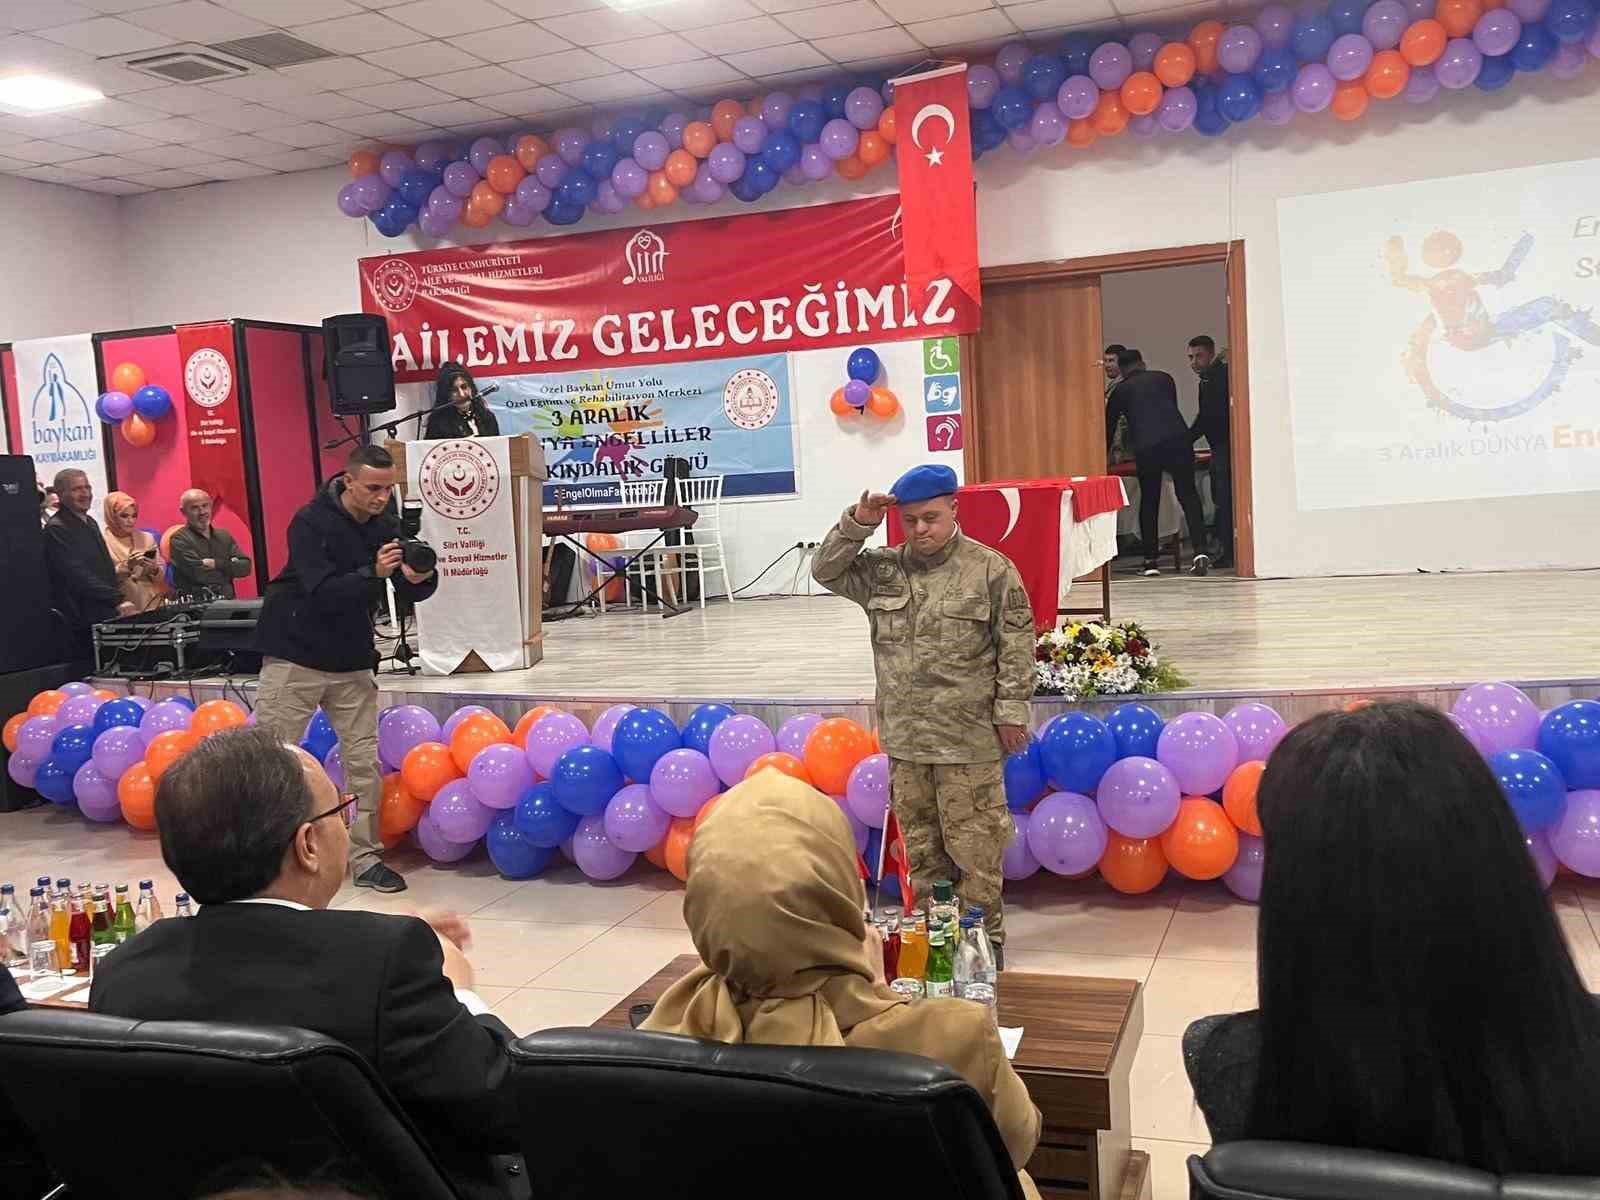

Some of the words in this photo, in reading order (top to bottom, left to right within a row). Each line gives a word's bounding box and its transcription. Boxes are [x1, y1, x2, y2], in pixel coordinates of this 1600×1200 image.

[391, 312, 579, 374] AİLEMİZ
[592, 274, 956, 357] GELECEĞİMİZ
[566, 383, 604, 395] Baykan
[606, 380, 635, 390] Umut
[638, 377, 663, 388] Yolu
[579, 389, 655, 404] Rehabilitasyon
[657, 386, 702, 398] Merkezi
[551, 410, 563, 427] 3
[570, 405, 650, 425] ARALIK
[32, 419, 93, 452] baykan
[580, 426, 712, 449] ENGELLİLER
[1377, 447, 1393, 463] 3
[546, 458, 644, 478] KINDALIK
[456, 526, 472, 535] T.C.
[443, 540, 458, 549] Siirt
[460, 539, 485, 550] Valiliği
[448, 553, 472, 564] Sosyal
[473, 551, 508, 562] Hizmetler
[451, 566, 489, 577] Müdürlüğü
